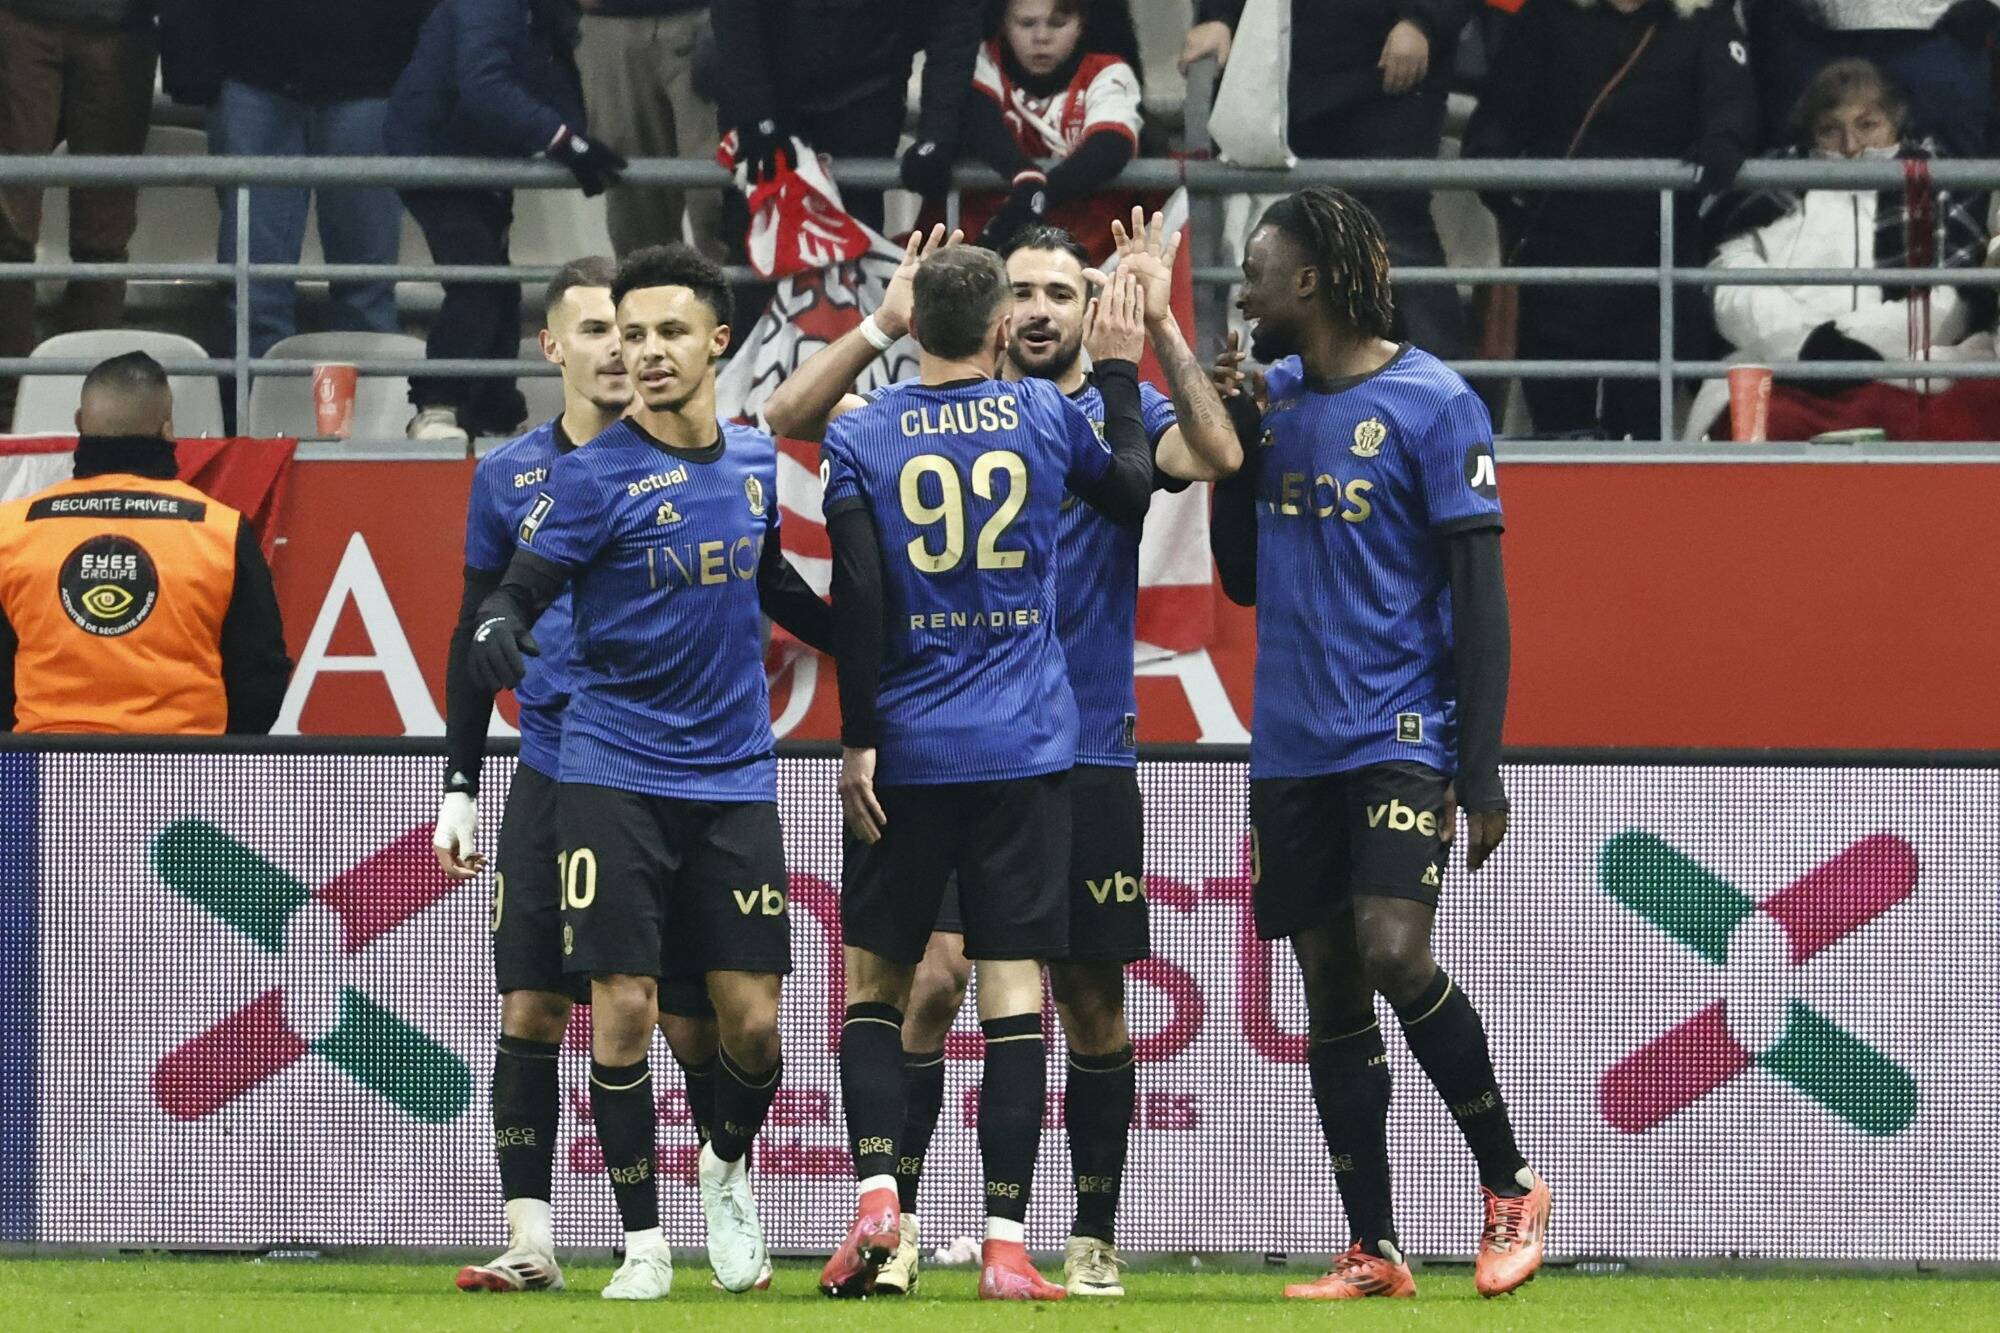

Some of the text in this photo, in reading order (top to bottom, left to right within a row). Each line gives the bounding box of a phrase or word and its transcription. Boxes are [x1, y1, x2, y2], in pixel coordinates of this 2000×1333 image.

[901, 395, 1019, 437] CLAUSS
[627, 464, 688, 497] actual
[900, 450, 1028, 573] 92
[81, 554, 137, 569] EYES
[80, 569, 137, 580] GROUPE
[558, 848, 597, 911] 10
[859, 1136, 893, 1148] OGC
[860, 1144, 893, 1156] NICE
[986, 1181, 1020, 1193] OGC
